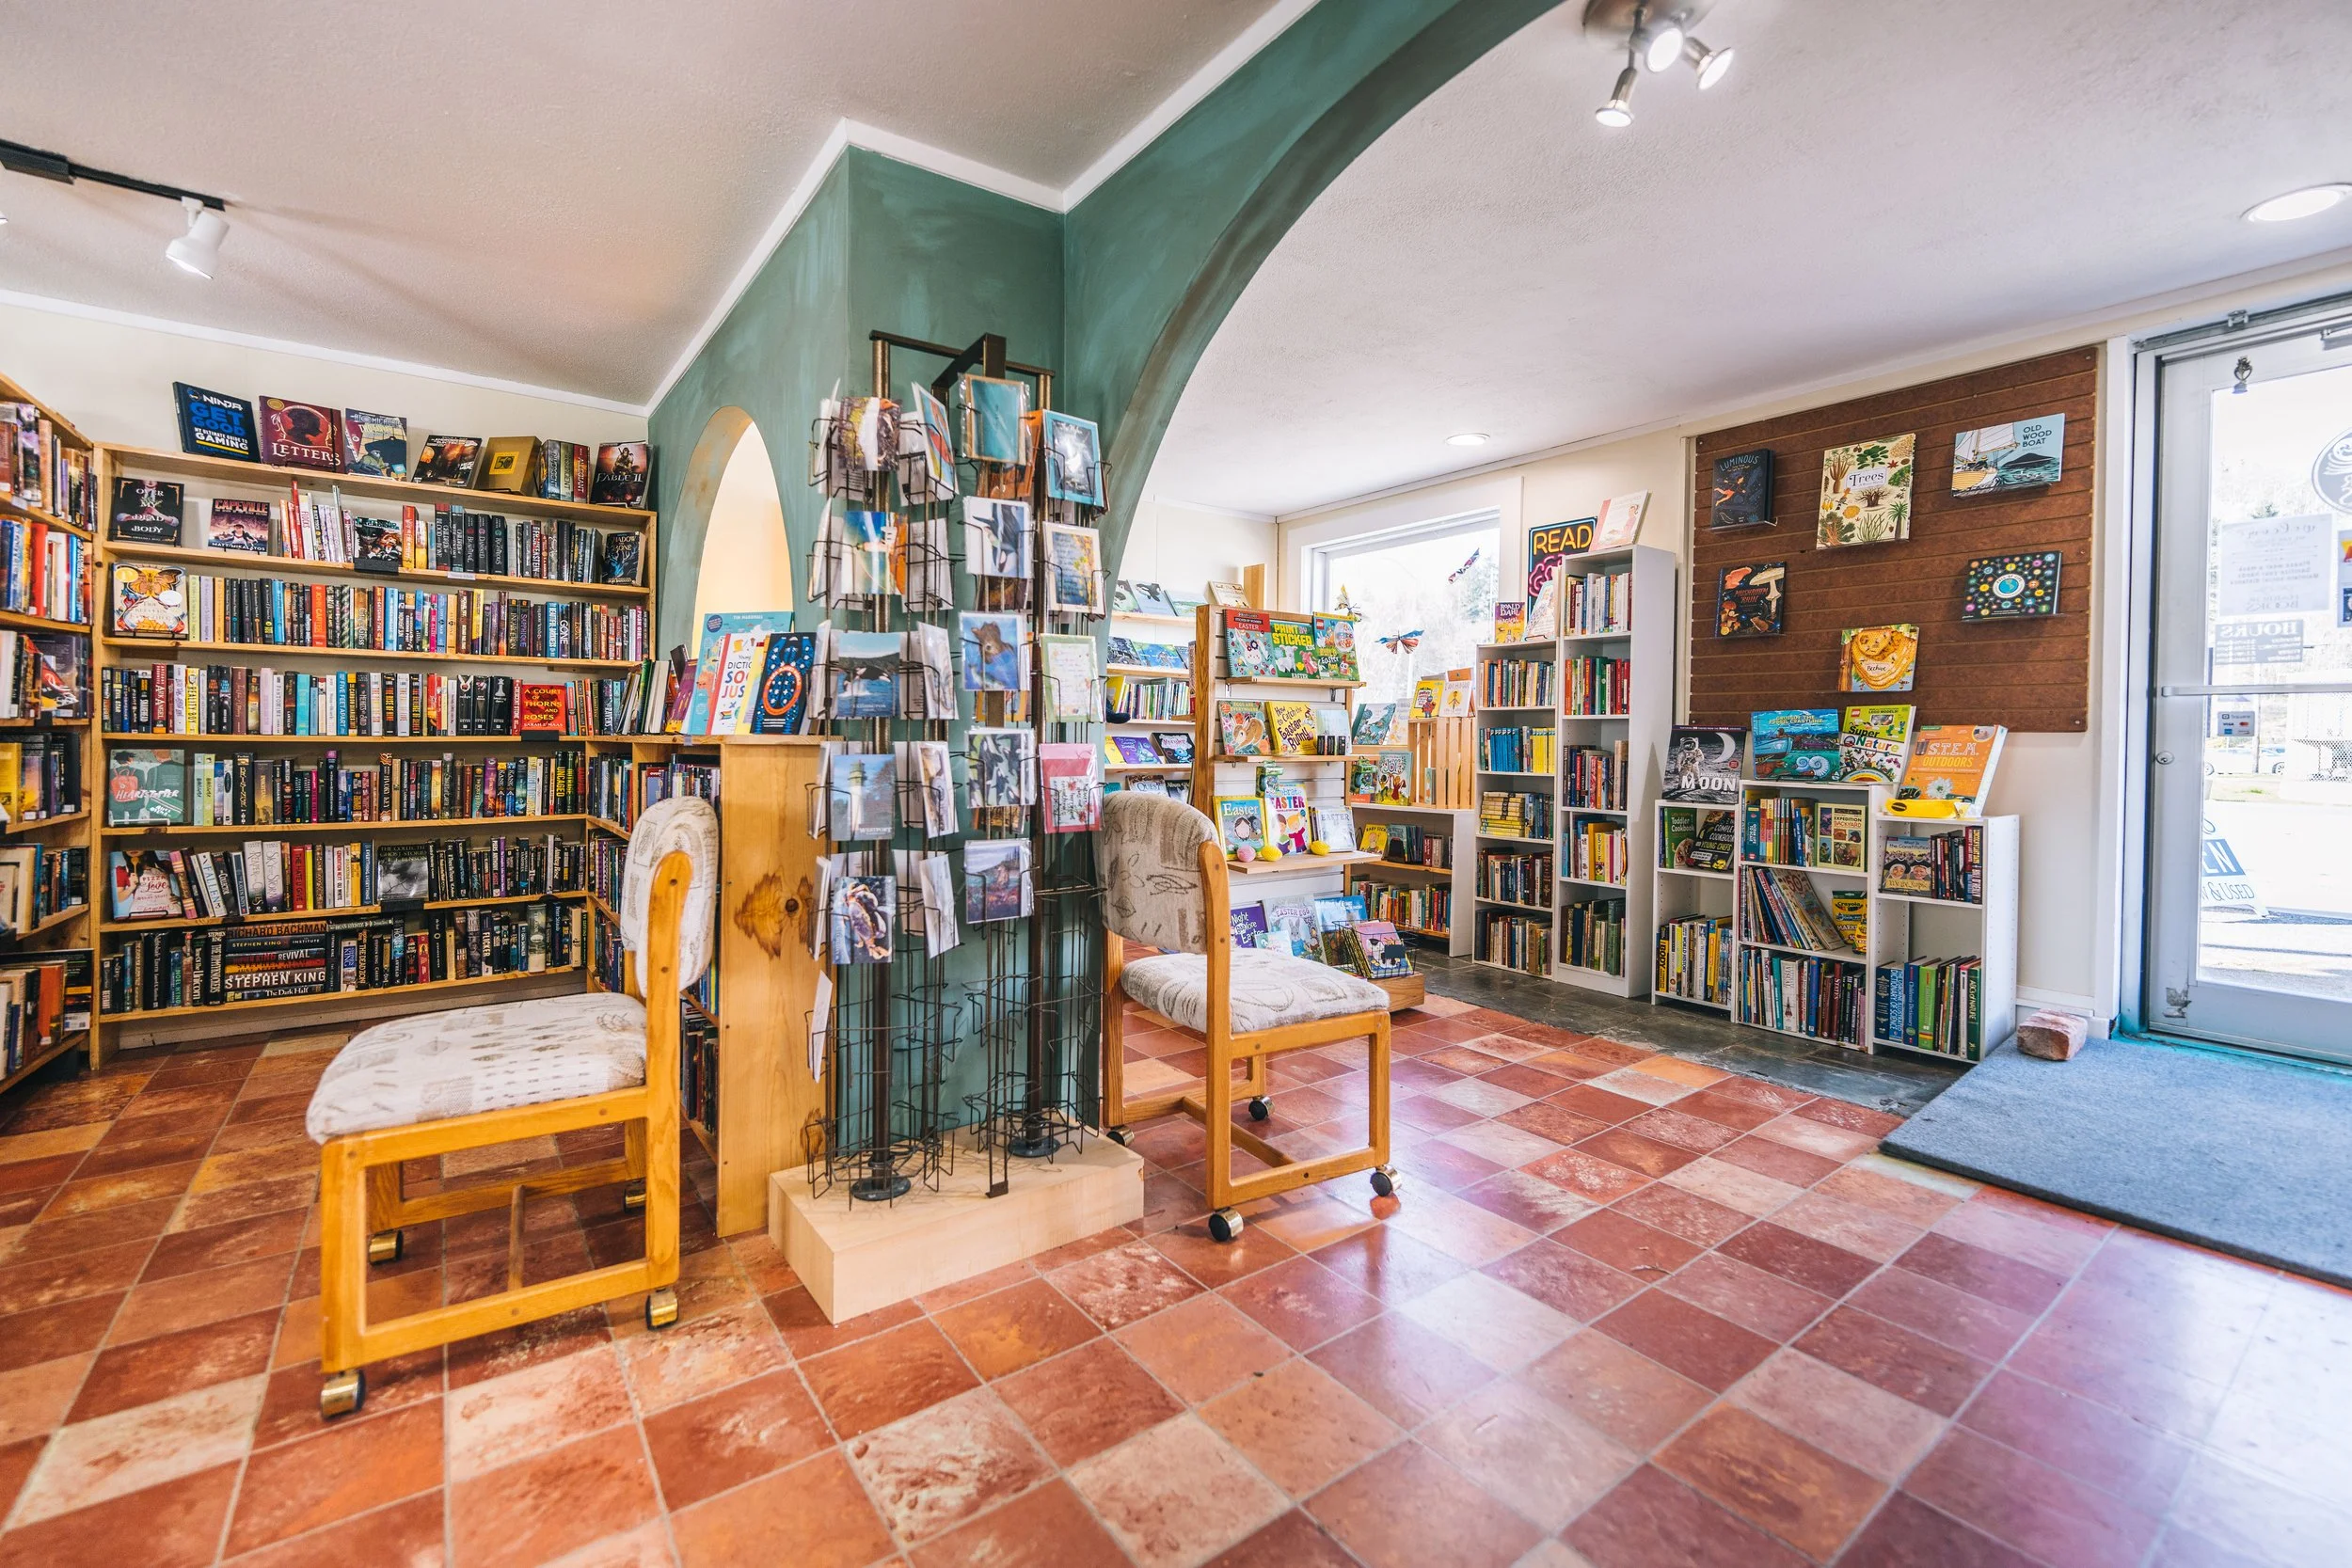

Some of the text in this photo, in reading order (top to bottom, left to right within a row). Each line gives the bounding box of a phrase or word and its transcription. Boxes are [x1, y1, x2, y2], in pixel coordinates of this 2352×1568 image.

[203, 395, 243, 410] NINJA
[190, 402, 245, 426] GET
[192, 415, 247, 437] GOOD
[2023, 424, 2042, 434] OLD
[196, 433, 249, 451] GAMING
[2022, 437, 2046, 448] BOAT
[2023, 429, 2053, 441] WOOD
[273, 442, 342, 467] LETTERS
[494, 456, 516, 469] 50
[1720, 455, 1759, 473] LUMINOUS
[596, 473, 632, 483] FABLE
[1848, 472, 1884, 486] Trees
[215, 499, 268, 513] CAPEVILLE
[132, 526, 163, 534] BODY
[1533, 525, 1593, 556] READ
[1736, 587, 1769, 596] MUSHROOM
[1500, 609, 1520, 617] DAHL
[560, 619, 568, 644] GONE
[1273, 624, 1298, 634] PAINT
[1272, 633, 1314, 647] STICKER
[155, 685, 165, 720] ARK ANGEL
[188, 686, 198, 723] REALITY BOY
[1274, 705, 1286, 717] How
[1281, 707, 1296, 722] Catch
[1278, 719, 1301, 741] Easter
[1848, 724, 1881, 737] Super
[1287, 727, 1311, 751] Bunny
[1855, 736, 1899, 752] Nature
[1922, 756, 1974, 768] OUTDOORS
[556, 767, 565, 797] UNCAGED
[1681, 774, 1738, 791] MOON
[115, 788, 180, 800] HEARTSTOPPER
[1222, 802, 1259, 816] Easter
[1321, 813, 1350, 821] EASTER
[1701, 841, 1732, 851] YOUNG CHEFS
[203, 865, 221, 903] FALLEN
[2218, 883, 2255, 900] USED
[1231, 911, 1249, 926] Night
[1276, 909, 1298, 918] EASTER
[228, 926, 274, 938] RICHARD
[277, 923, 327, 934] BACHMAN
[482, 931, 490, 957] FLICKER
[278, 949, 310, 960] REVIVAL
[192, 970, 204, 1000] Unicorn
[224, 971, 326, 990] STEPHEN KING
[265, 989, 278, 997] The
[278, 988, 293, 996] Dark
